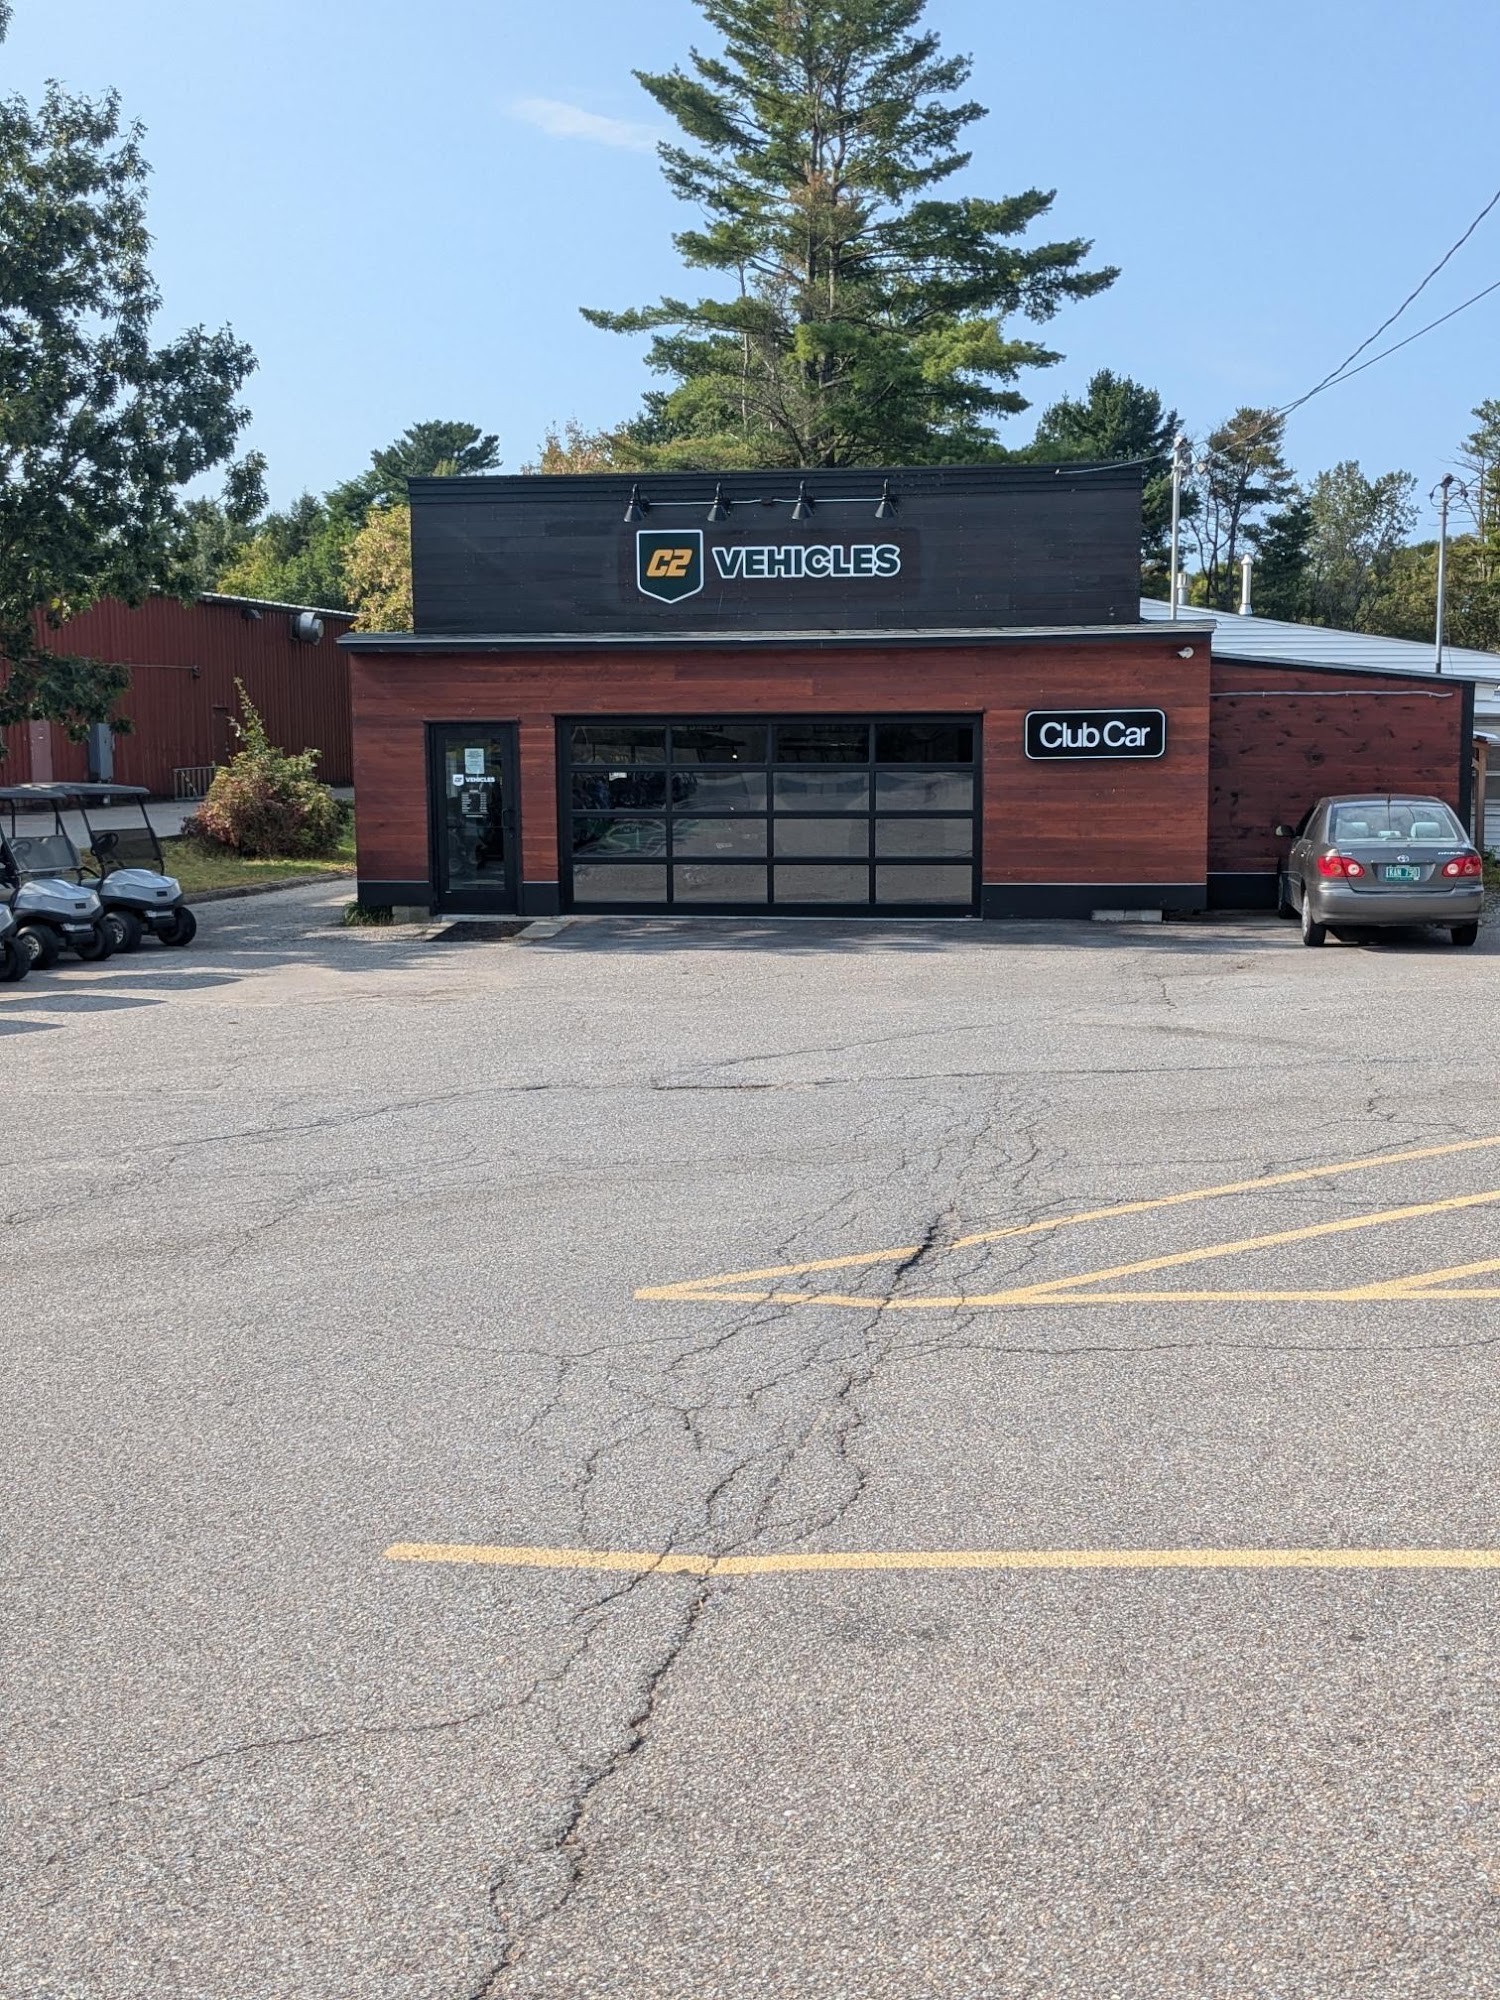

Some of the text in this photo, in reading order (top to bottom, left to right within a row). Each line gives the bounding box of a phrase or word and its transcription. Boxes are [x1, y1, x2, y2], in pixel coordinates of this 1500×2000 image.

[646, 545, 901, 578] C2 VEHICLES
[1039, 720, 1150, 748] Club Car
